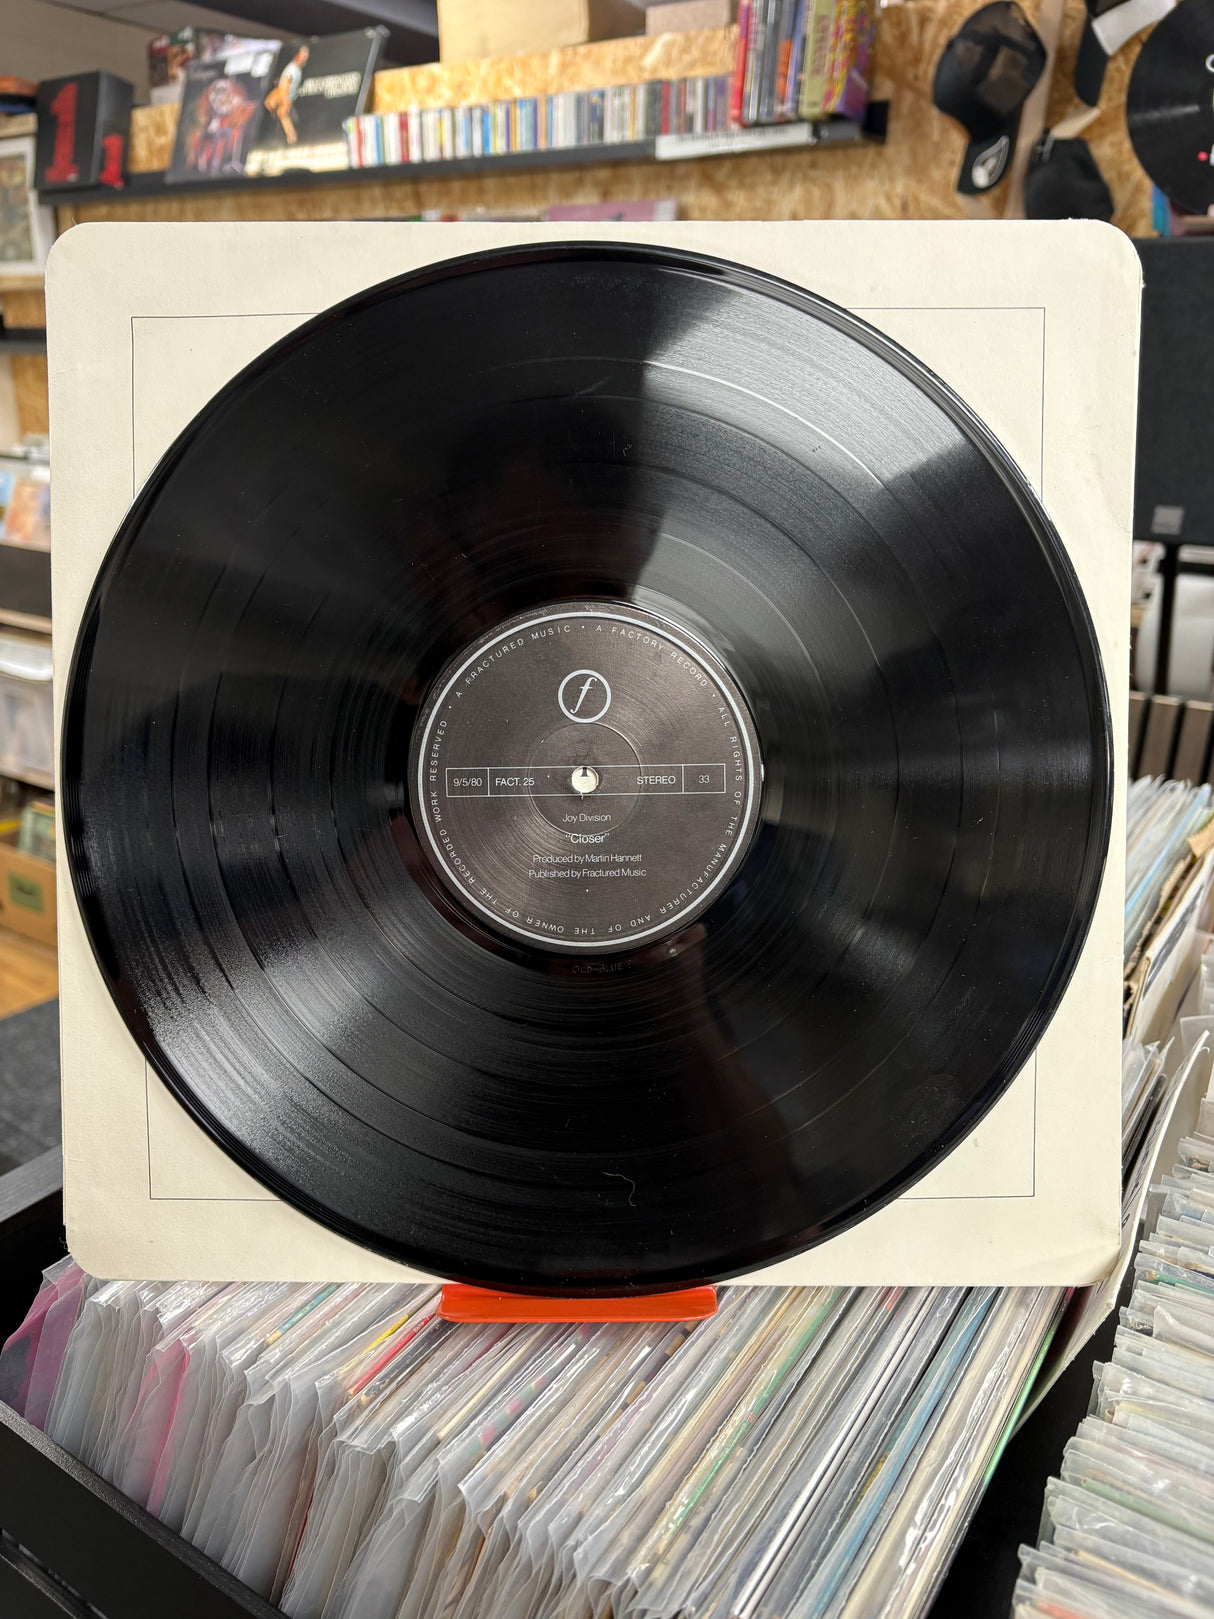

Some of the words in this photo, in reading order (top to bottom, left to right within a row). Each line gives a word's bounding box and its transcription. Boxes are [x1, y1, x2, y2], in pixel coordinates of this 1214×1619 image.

[465, 638, 524, 685] FRACTURED
[531, 625, 571, 640] MUSIC
[611, 626, 664, 651] FACTORY
[670, 651, 708, 687] RECORD
[717, 706, 732, 728] ALL
[430, 720, 447, 781] RESERVED
[730, 736, 743, 781] RIGHTS
[453, 777, 483, 787] 9/5/80
[495, 777, 522, 787] FACT.
[523, 777, 535, 786] 25
[636, 775, 676, 785] STEREO
[698, 775, 710, 784] 33
[734, 791, 742, 806] OF
[431, 791, 442, 823] WORK
[562, 813, 578, 824] Joy
[579, 813, 612, 822] Division
[725, 816, 738, 836] THE
[439, 829, 476, 884] RECORDED
[532, 854, 573, 863] Produced
[574, 854, 584, 864] by
[585, 854, 609, 863] Martin
[610, 853, 642, 863] Hannett
[528, 869, 570, 878] Published
[571, 868, 582, 879] by
[582, 868, 620, 877] Fractured
[621, 867, 647, 877] Music
[659, 843, 727, 914] MANUFACTURER
[479, 887, 498, 905] THE
[505, 907, 520, 917] OF
[526, 916, 564, 933] OWNER
[630, 914, 651, 927] AND
[574, 927, 596, 935] THE
[608, 924, 622, 933] OF
